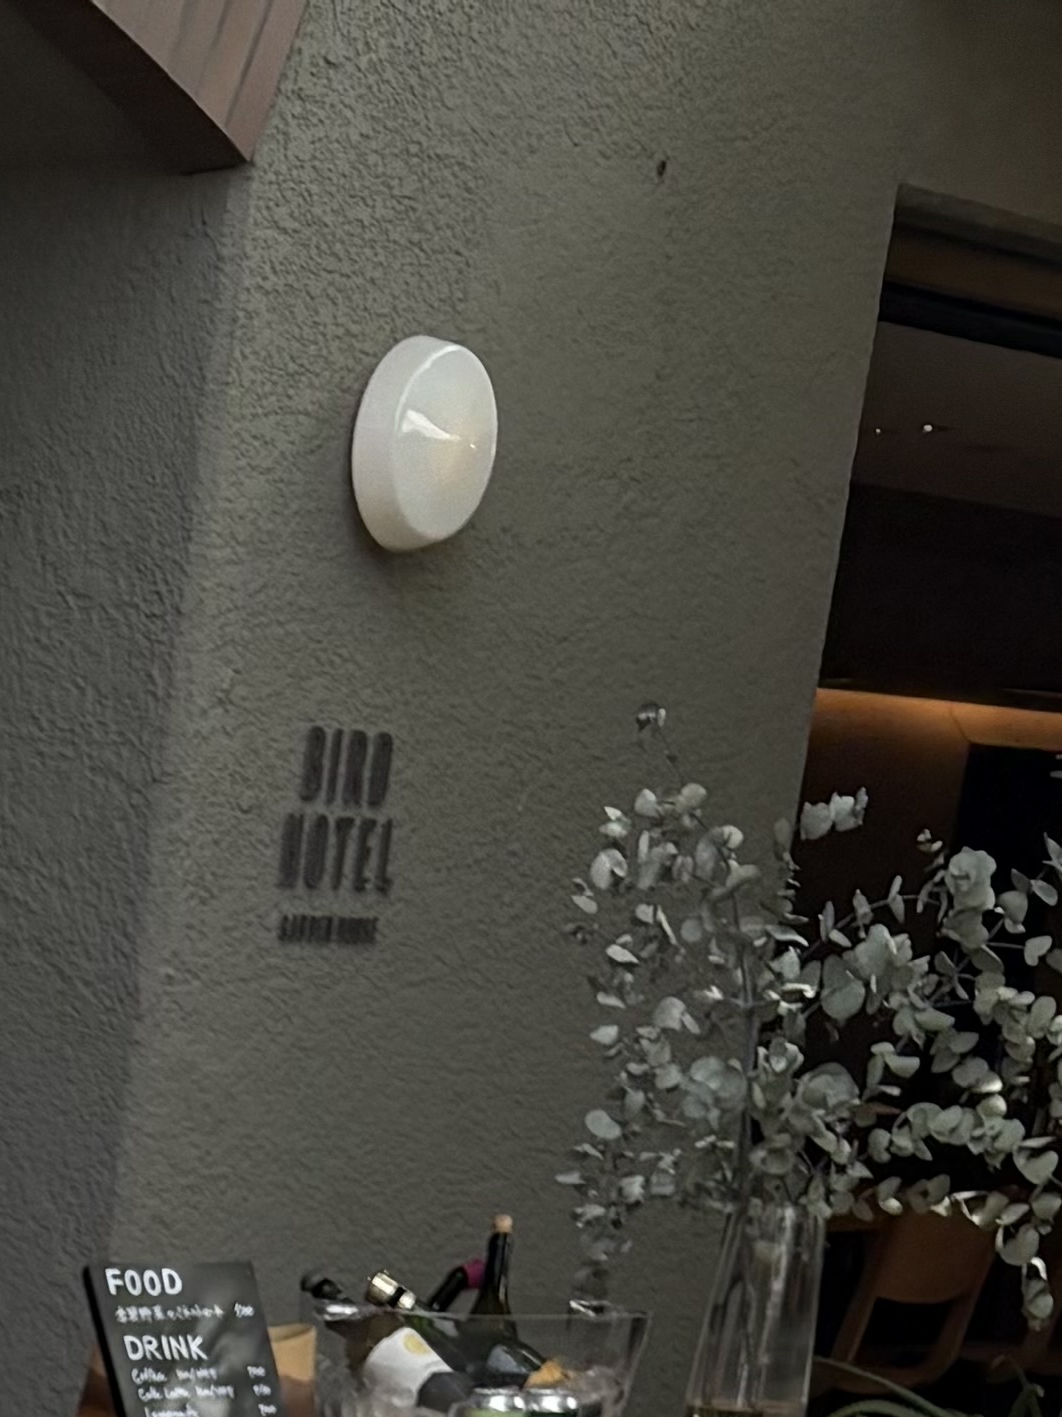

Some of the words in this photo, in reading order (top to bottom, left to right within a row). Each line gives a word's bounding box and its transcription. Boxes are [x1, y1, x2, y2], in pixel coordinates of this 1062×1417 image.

[278, 813, 393, 894] HOTEL
[105, 1267, 183, 1296] FOOD
[123, 1334, 208, 1361] DRINK
